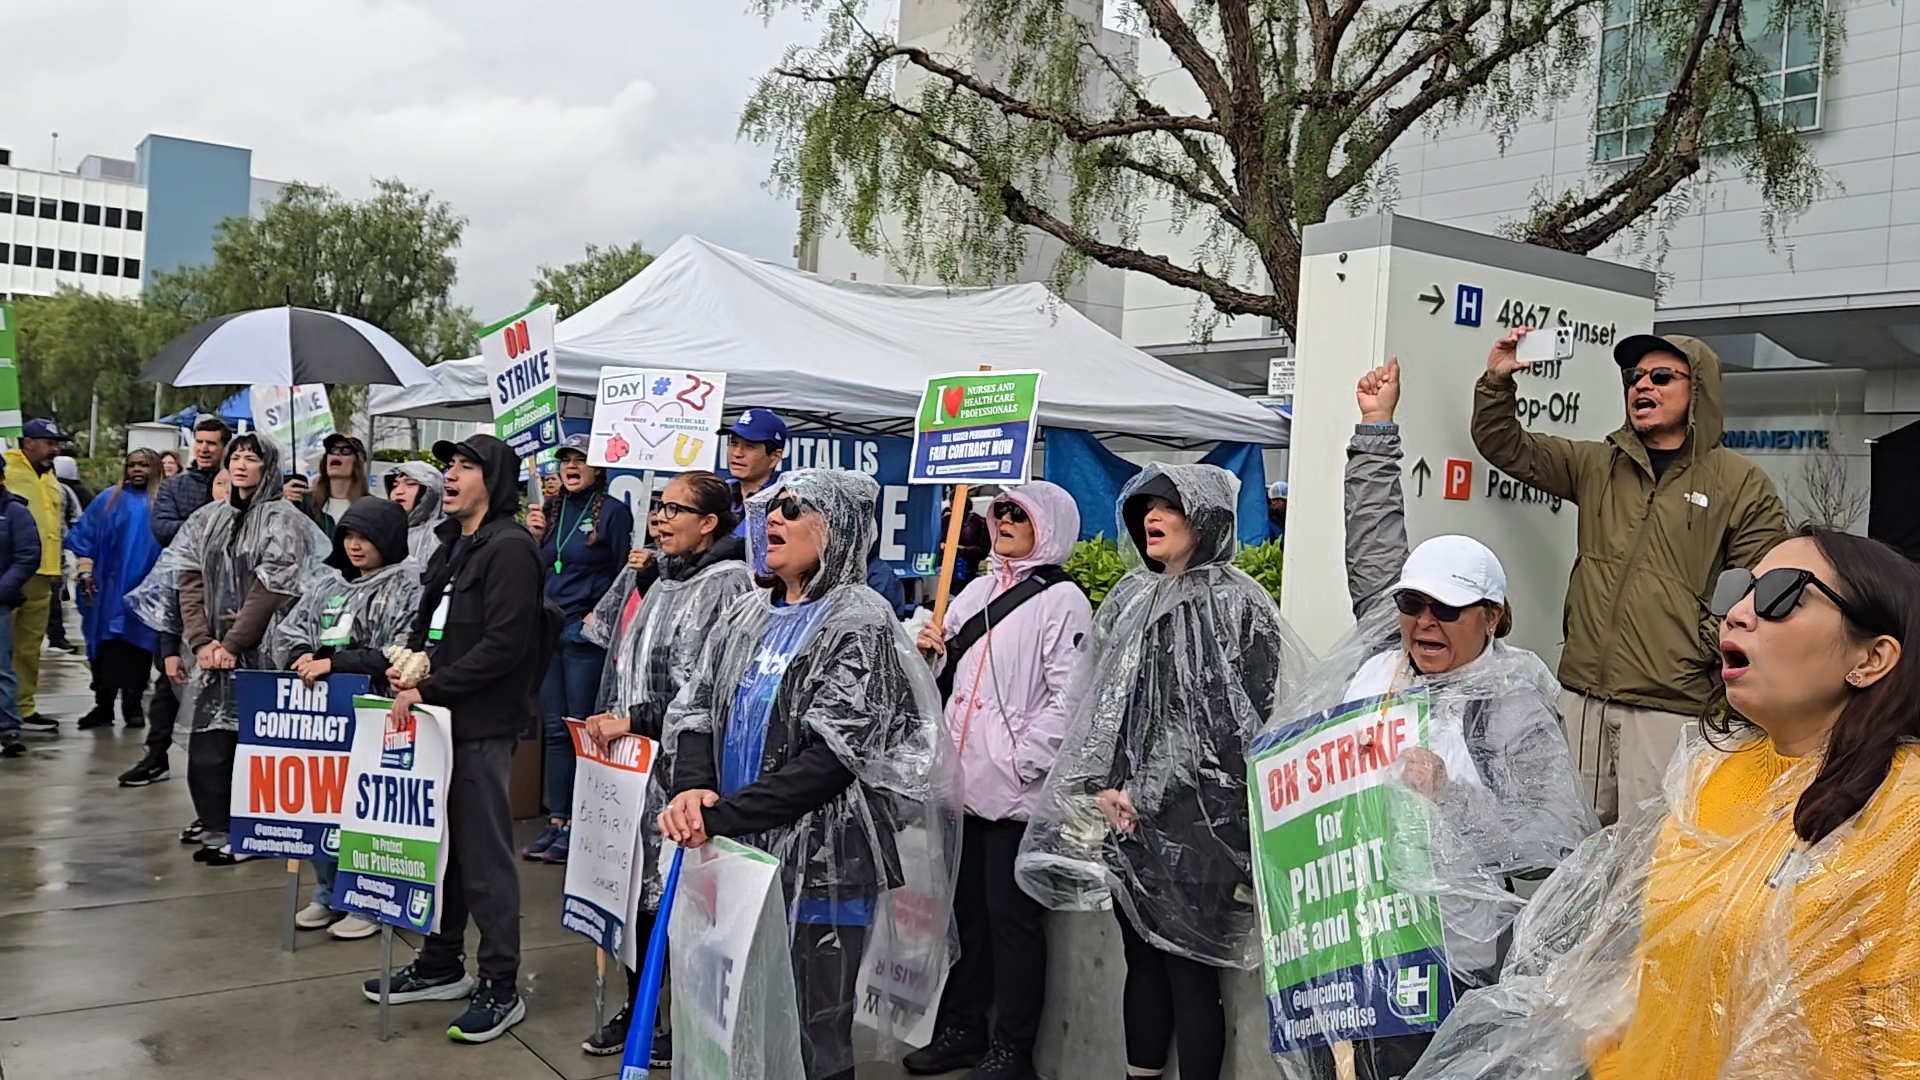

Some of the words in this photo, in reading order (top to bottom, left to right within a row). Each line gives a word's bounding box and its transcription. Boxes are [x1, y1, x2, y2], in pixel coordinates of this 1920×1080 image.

[1461, 290, 1477, 321] H
[1496, 299, 1551, 329] 4867
[1558, 309, 1616, 346] Sunset
[503, 319, 531, 360] ON
[496, 349, 551, 405] STRIKE
[607, 382, 640, 398] DAY
[651, 377, 672, 396] #
[967, 384, 997, 395] NURSES
[996, 382, 1015, 393] AND
[933, 385, 947, 425] I
[960, 404, 1018, 419] PROFESSIONALS
[964, 395, 993, 407] HEALTH
[993, 393, 1015, 403] CARE
[1516, 392, 1580, 428] op-Off
[674, 433, 704, 466] U
[929, 446, 948, 461] FAIR
[948, 441, 991, 459] CONTRACT
[991, 439, 1014, 455] NOW
[1720, 430, 1829, 450] RMANENTE
[855, 440, 878, 476] IS
[1452, 466, 1466, 494] P
[1487, 468, 1562, 514] Parking
[276, 678, 329, 713] FAIR
[254, 711, 349, 743] CONTRACT
[385, 731, 412, 751] STRIKE
[600, 735, 642, 768] RIKE
[1268, 758, 1300, 812] ON
[1306, 718, 1406, 794] STRIKE
[249, 755, 350, 814] NOW
[356, 773, 435, 827] STRIKE
[1315, 811, 1343, 846] for
[352, 849, 369, 871] Our
[370, 851, 426, 879] Professions
[1289, 837, 1384, 909] PATIENT
[1272, 922, 1310, 967] CARE
[1312, 908, 1351, 951] and
[1293, 981, 1354, 1011] @unacuhcp
